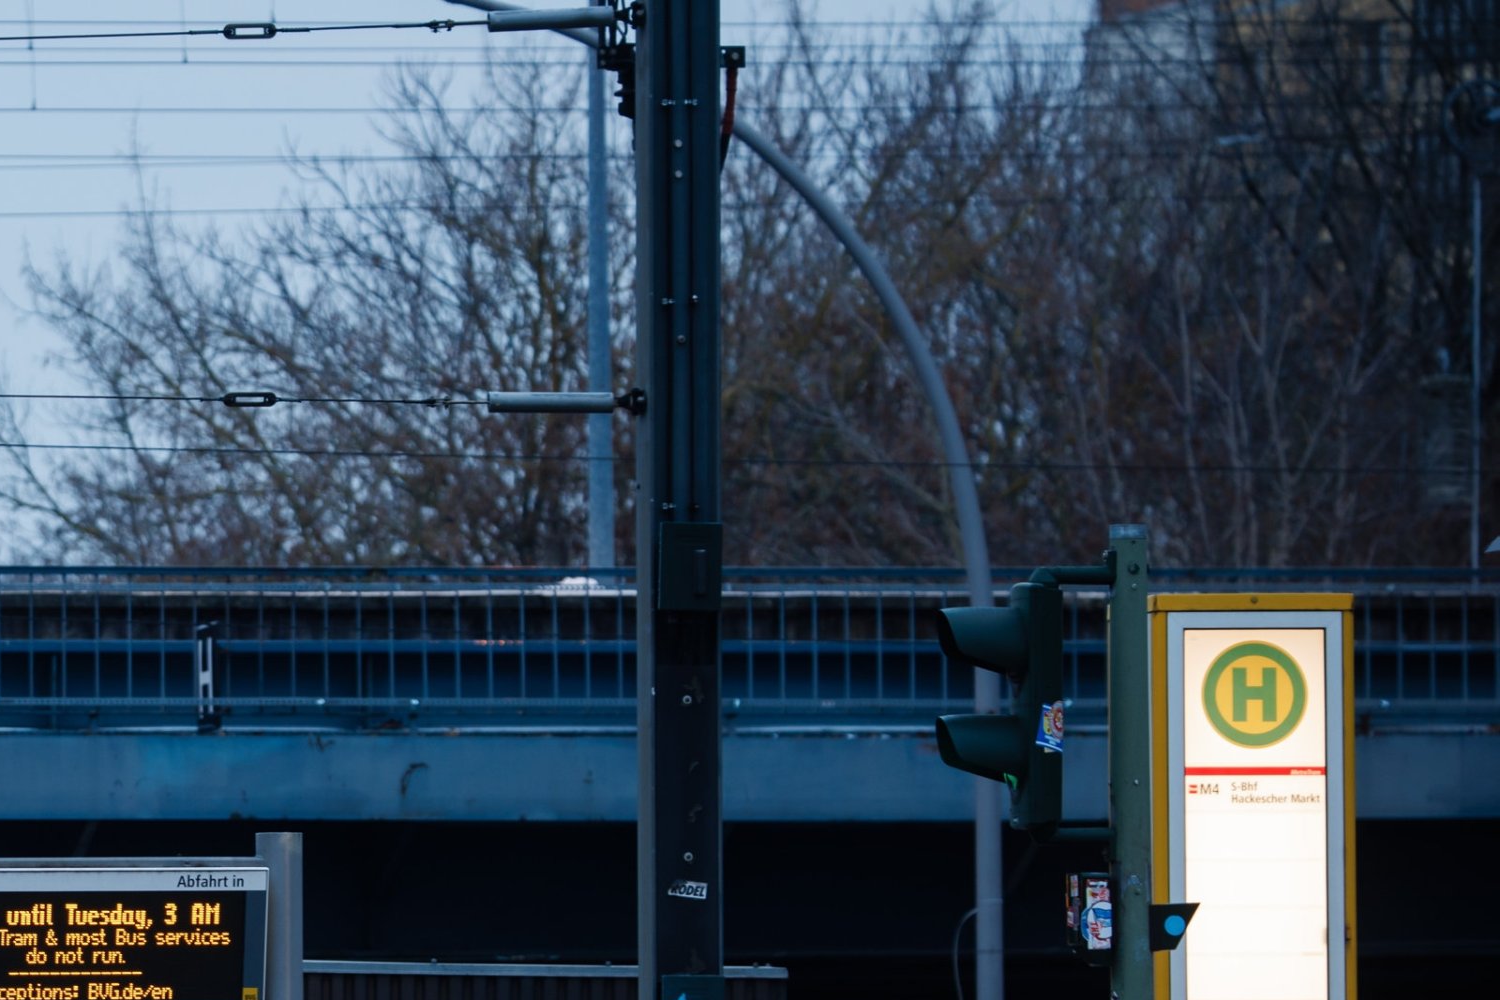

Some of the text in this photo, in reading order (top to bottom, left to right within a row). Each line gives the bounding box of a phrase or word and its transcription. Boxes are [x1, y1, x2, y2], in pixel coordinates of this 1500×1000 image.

[1232, 667, 1277, 722] H
[1200, 783, 1220, 795] M4
[1231, 782, 1258, 792] S-Bhf
[1231, 794, 1320, 804] Hackescher Markt
[177, 874, 245, 888] Abfahrt in
[6, 904, 53, 926] until
[65, 903, 153, 929] Tuesday,
[164, 904, 177, 926] 3
[191, 903, 220, 925] AM
[45, 930, 58, 946] &
[66, 930, 107, 946] most
[115, 929, 147, 945] Bus
[155, 930, 231, 946] services
[26, 948, 126, 964] do not run.
[88, 983, 173, 1000] BVG.de/en
